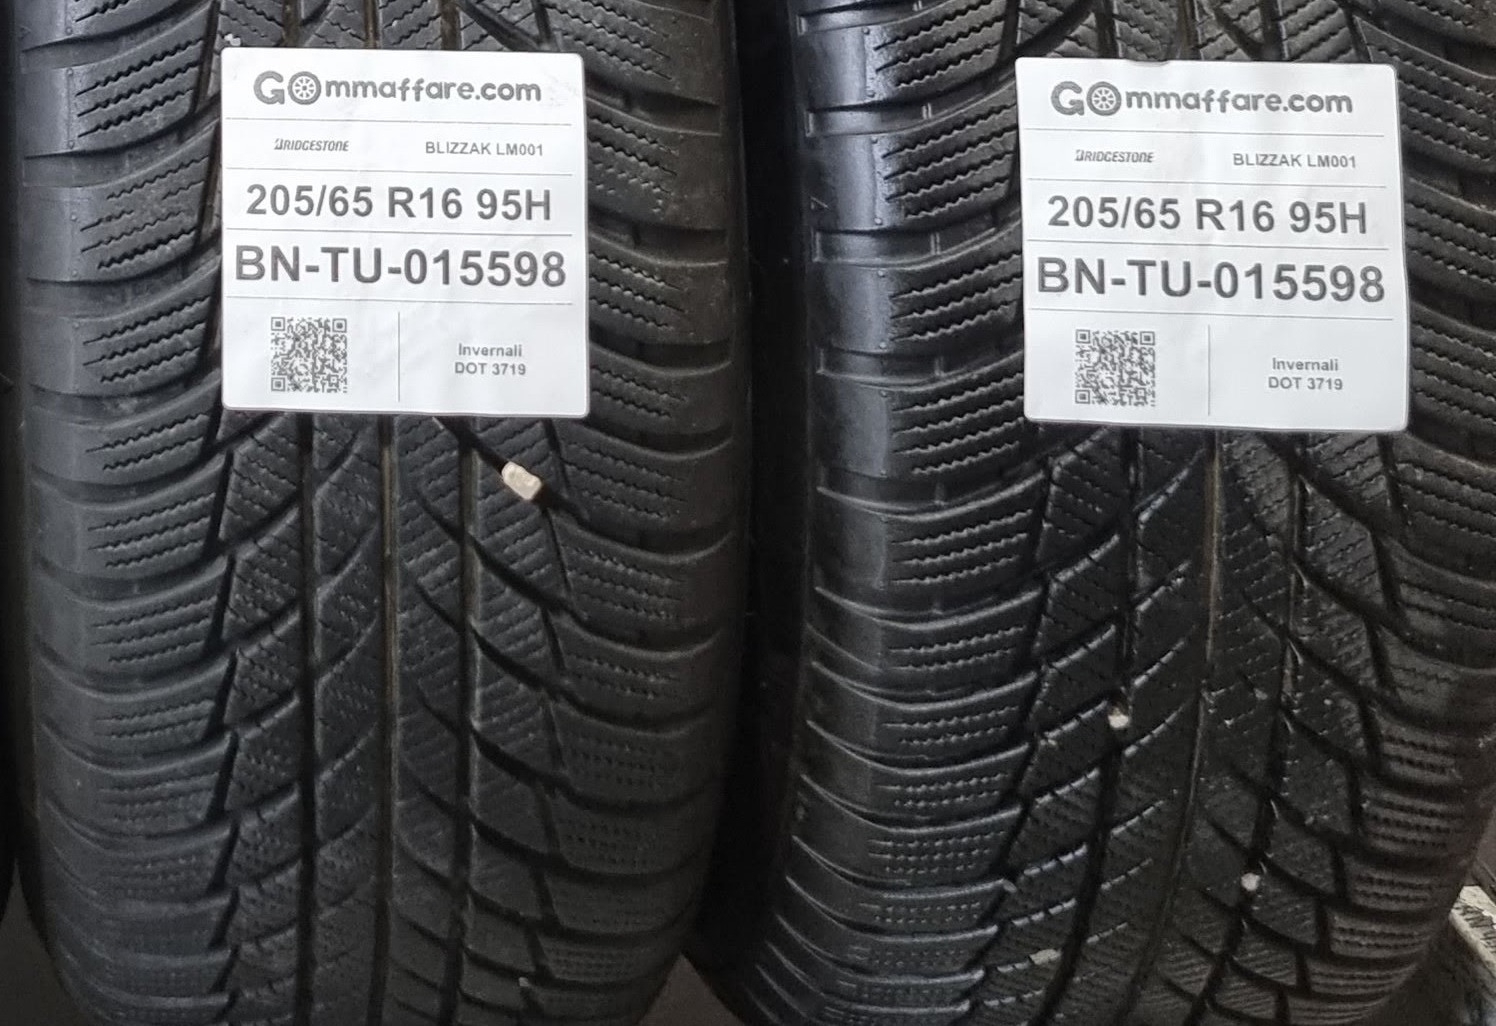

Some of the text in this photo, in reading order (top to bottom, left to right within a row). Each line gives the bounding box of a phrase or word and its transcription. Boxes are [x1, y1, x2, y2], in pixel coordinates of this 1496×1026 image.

[274, 139, 349, 151] BRIDGESTONE
[426, 142, 542, 156] BLIZZAK LM001
[1075, 150, 1153, 163] BRIDGESTONE
[1233, 153, 1355, 168] BLIZZAK LM001
[247, 184, 550, 220] 205/65 R16 95H
[1048, 196, 1366, 234] 205/65 R16 95H
[236, 246, 566, 287] BN-TU-015598
[1039, 257, 1384, 302] BN-TU-015598
[459, 343, 522, 357] Invernali
[455, 362, 526, 375] DOT 3719
[1273, 358, 1338, 371] Invernali
[1269, 377, 1343, 390] DOT 3719
